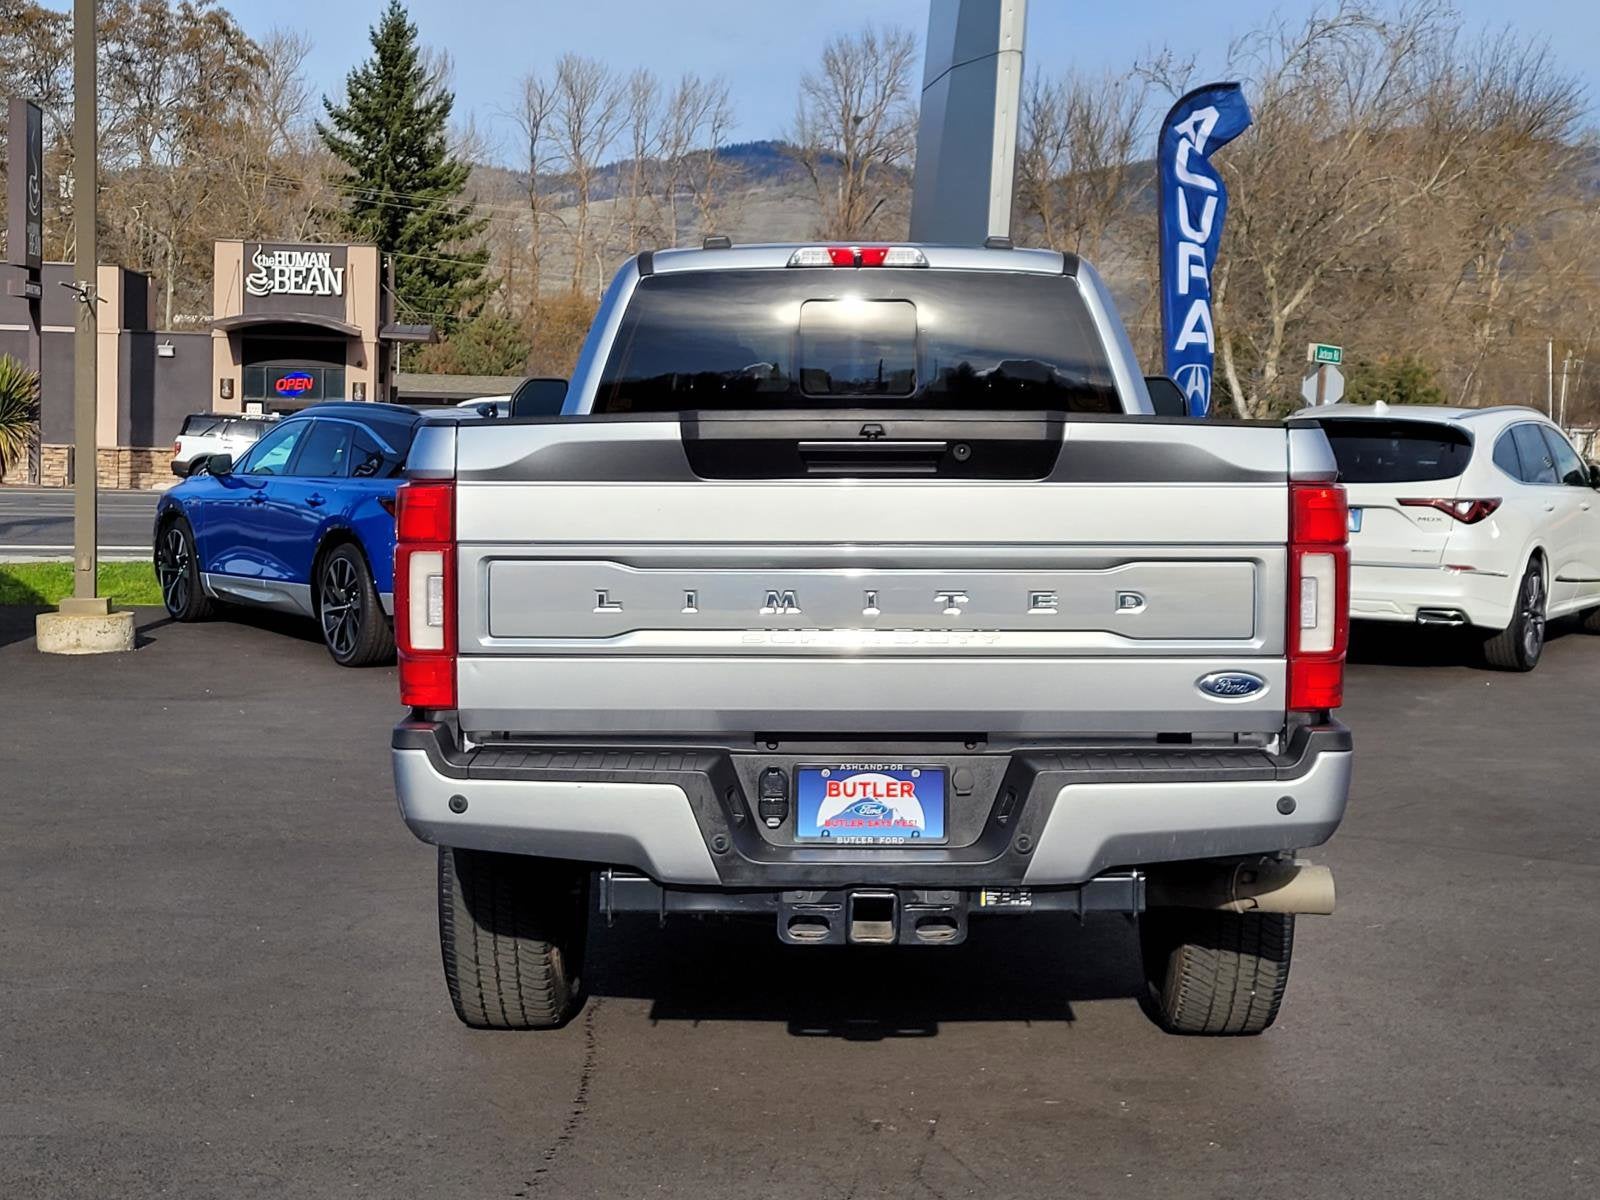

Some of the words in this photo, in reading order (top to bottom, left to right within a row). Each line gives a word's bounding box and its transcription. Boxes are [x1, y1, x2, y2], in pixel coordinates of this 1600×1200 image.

[1174, 106, 1220, 354] ACURA
[257, 254, 275, 267] the
[273, 250, 331, 268] HUMAN
[270, 266, 345, 295] BEAN
[275, 377, 314, 392] OPEN
[1215, 678, 1251, 693] Ford
[827, 781, 915, 798] BUTLER
[859, 803, 884, 815] Ford
[825, 818, 864, 828] BUTLER
[836, 836, 874, 844] BUTLER
[879, 836, 905, 844] FORD
